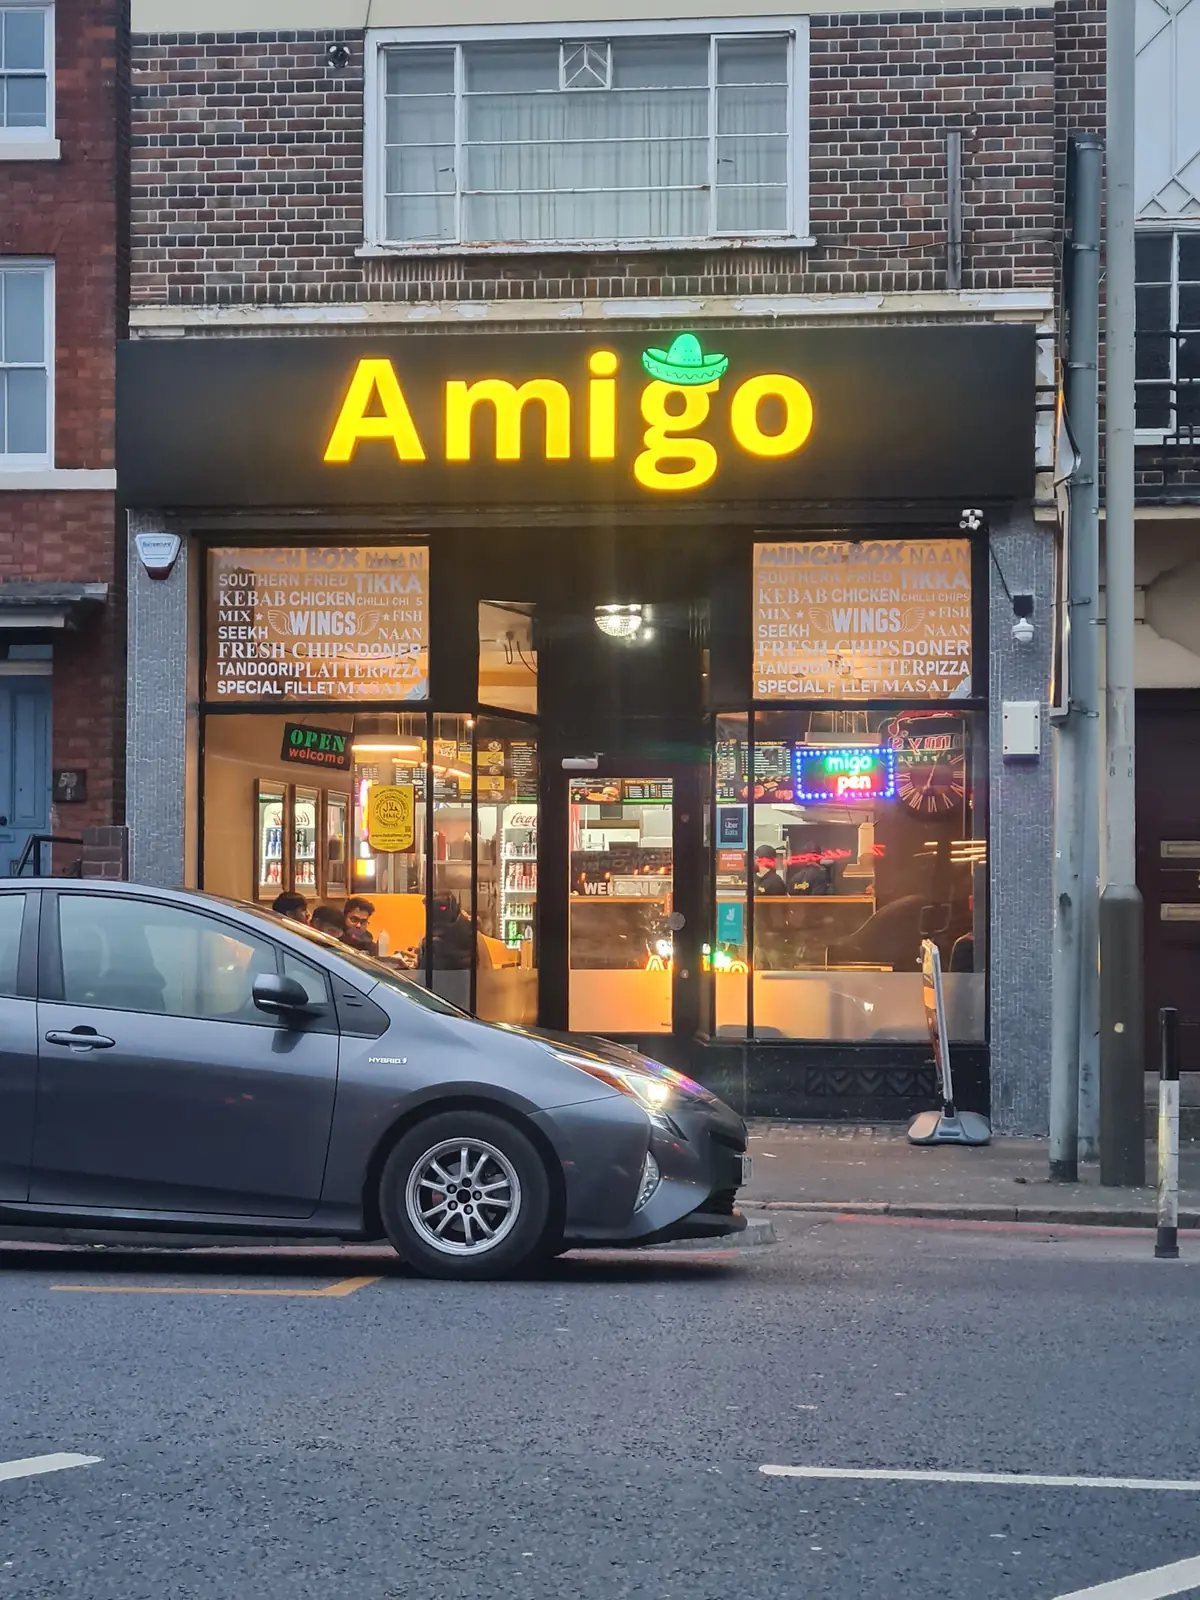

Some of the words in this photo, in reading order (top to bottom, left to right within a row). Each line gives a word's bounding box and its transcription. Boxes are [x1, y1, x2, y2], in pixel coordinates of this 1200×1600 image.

[323, 350, 814, 490] Amigo
[306, 547, 360, 569] BOX
[365, 551, 423, 569] NAAN
[849, 543, 904, 566] BOX
[909, 547, 970, 564] NAAN
[219, 573, 299, 587] SOUTHERN
[304, 573, 349, 587] FRIED
[354, 573, 422, 593] TIKKA
[759, 570, 842, 584] SOUTHERN
[847, 570, 893, 584] FRIED
[899, 569, 970, 589] TIKKA
[219, 590, 286, 607] KEBAB
[289, 591, 356, 606] CHICKEN
[356, 597, 389, 606] CHILLI
[392, 597, 423, 606] CHIS
[759, 588, 828, 604] KEBAB
[831, 588, 900, 603] CHICKEN
[901, 593, 935, 602] CHILLI
[938, 592, 970, 602] CHIPS
[218, 610, 251, 622] MIX
[289, 610, 357, 636] WINGS
[392, 610, 423, 622] FISH
[758, 608, 791, 620] MIX
[832, 607, 901, 633] WINGS
[939, 606, 970, 618] FISH
[218, 626, 268, 640] SEEKH
[378, 627, 422, 640] NAAN
[758, 624, 810, 638] SEEKH
[924, 624, 970, 637] NAAN
[218, 642, 286, 659] FRESH
[292, 642, 356, 659] CHIPS
[357, 643, 421, 659] DONER
[758, 640, 828, 657] FRESH
[834, 639, 900, 657] CHIPS
[902, 640, 970, 656] DONER
[217, 662, 293, 676] TANDOORI
[293, 662, 380, 678] PLATTER
[379, 664, 422, 678] PIZZA
[926, 660, 970, 675] PIZZA
[217, 680, 281, 694] SPECIAL
[284, 681, 336, 694] FILLET
[758, 680, 825, 694] SPECIAL
[827, 679, 880, 693] FLLET
[882, 679, 970, 693] MASALA
[290, 729, 347, 752] OPEN
[289, 747, 345, 765] welcome
[827, 754, 872, 775] migo
[836, 774, 872, 796] pen
[724, 821, 739, 829] Uber
